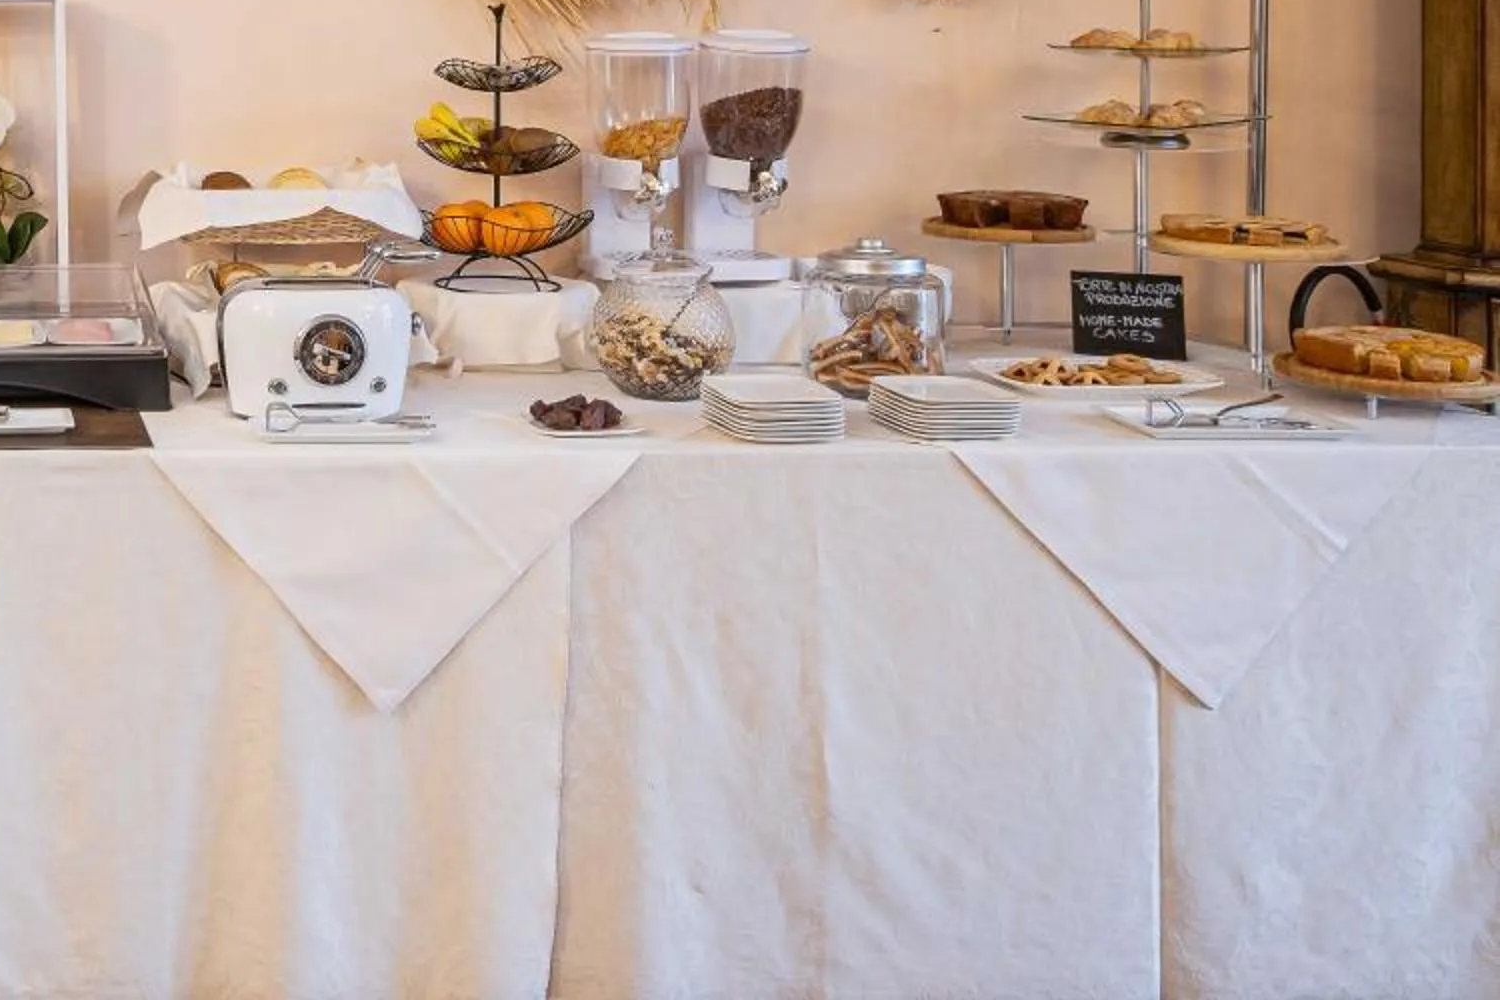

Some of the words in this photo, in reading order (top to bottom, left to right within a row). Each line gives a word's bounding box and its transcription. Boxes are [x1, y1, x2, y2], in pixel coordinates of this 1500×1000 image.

[1072, 278, 1117, 292] TORTE
[1135, 283, 1182, 295] NOSTRA
[1084, 292, 1176, 308] PRODUZIONE
[1080, 315, 1163, 328] HOME-MADE
[1093, 327, 1155, 343] CAKES
